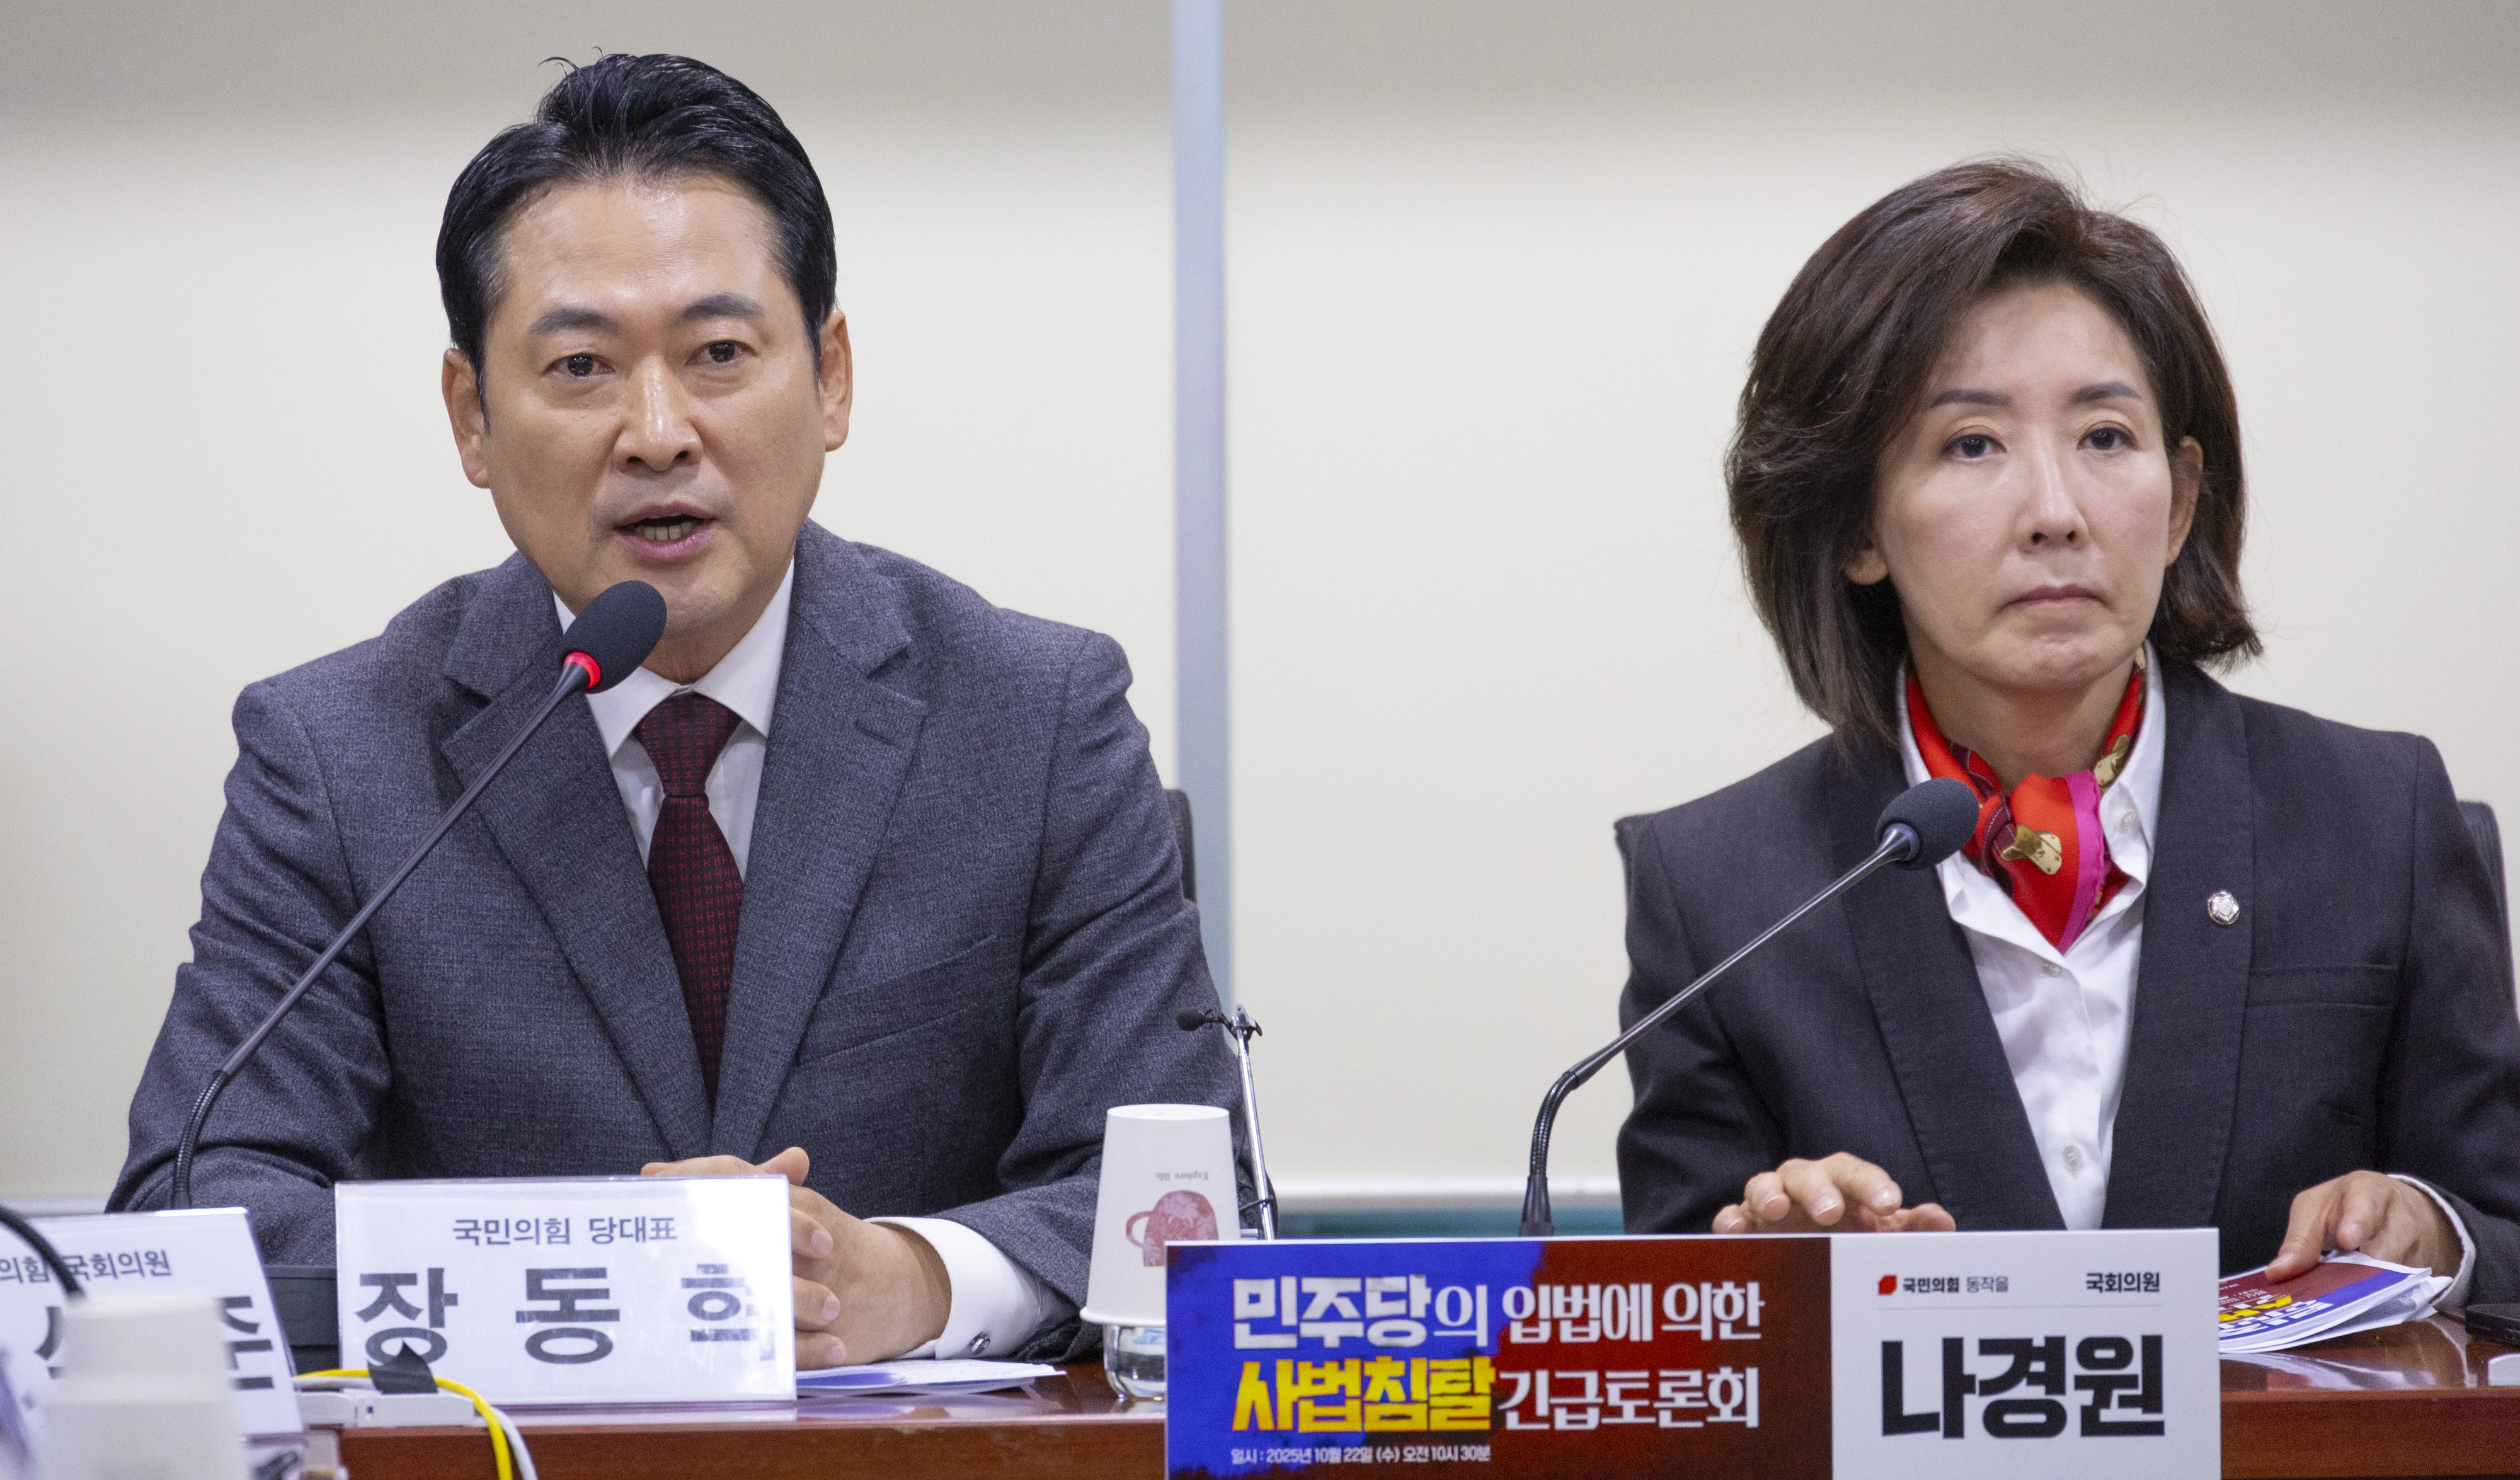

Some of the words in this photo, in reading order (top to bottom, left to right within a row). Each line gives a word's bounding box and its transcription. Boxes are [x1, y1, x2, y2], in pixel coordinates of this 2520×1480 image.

[1174, 1170, 1208, 1182] Explore
[453, 1217, 571, 1245] 국민의힘
[589, 1217, 677, 1243] 당대표
[60, 1249, 172, 1282] 국회의원
[1903, 1276, 1960, 1294] 국민의힘
[1966, 1276, 2009, 1293] 동작을
[2086, 1271, 2160, 1293] 국회의원
[1233, 1274, 1489, 1350] 민주당의
[1501, 1283, 1653, 1344] 입법에
[1661, 1281, 1766, 1341] 의한
[1231, 1355, 1496, 1433] 사법침탈
[1498, 1366, 1760, 1431] 긴급토론회
[1881, 1334, 2165, 1440] 나경원
[1266, 1448, 1312, 1464] 2025년
[1314, 1447, 1342, 1464] 10월
[1343, 1446, 1373, 1464] 22일
[1376, 1445, 1400, 1463] (수)
[1402, 1445, 1429, 1462] 오전
[1431, 1445, 1458, 1462] 10시
[1460, 1444, 1491, 1462] 30분
